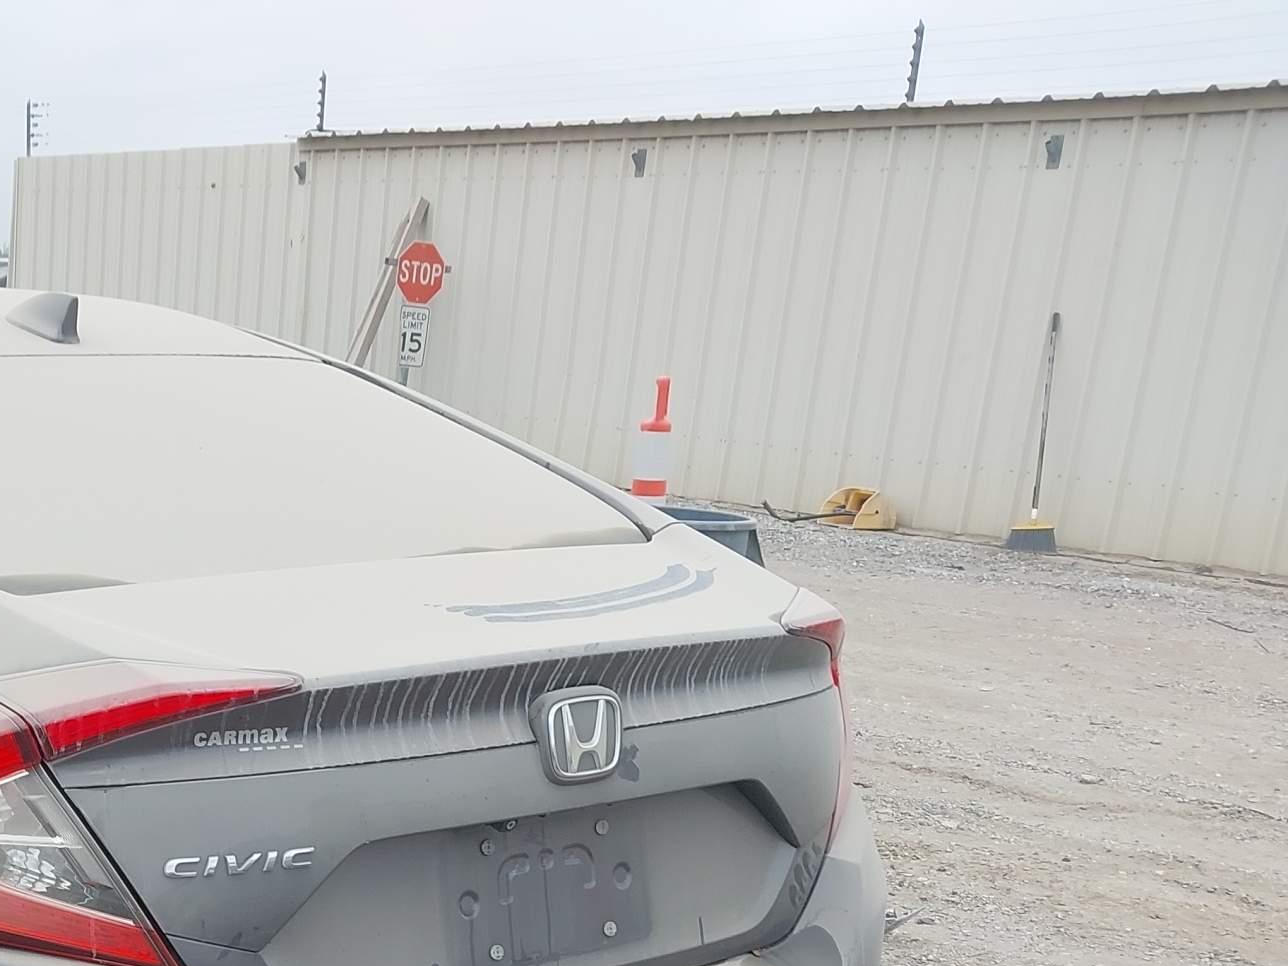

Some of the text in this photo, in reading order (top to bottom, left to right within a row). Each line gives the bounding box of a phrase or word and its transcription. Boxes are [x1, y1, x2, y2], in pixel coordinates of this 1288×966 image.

[400, 260, 442, 286] STOP
[402, 312, 427, 321] SPEED
[403, 321, 423, 330] LIMIT
[401, 331, 422, 353] 15
[164, 847, 314, 877] CIVIC
